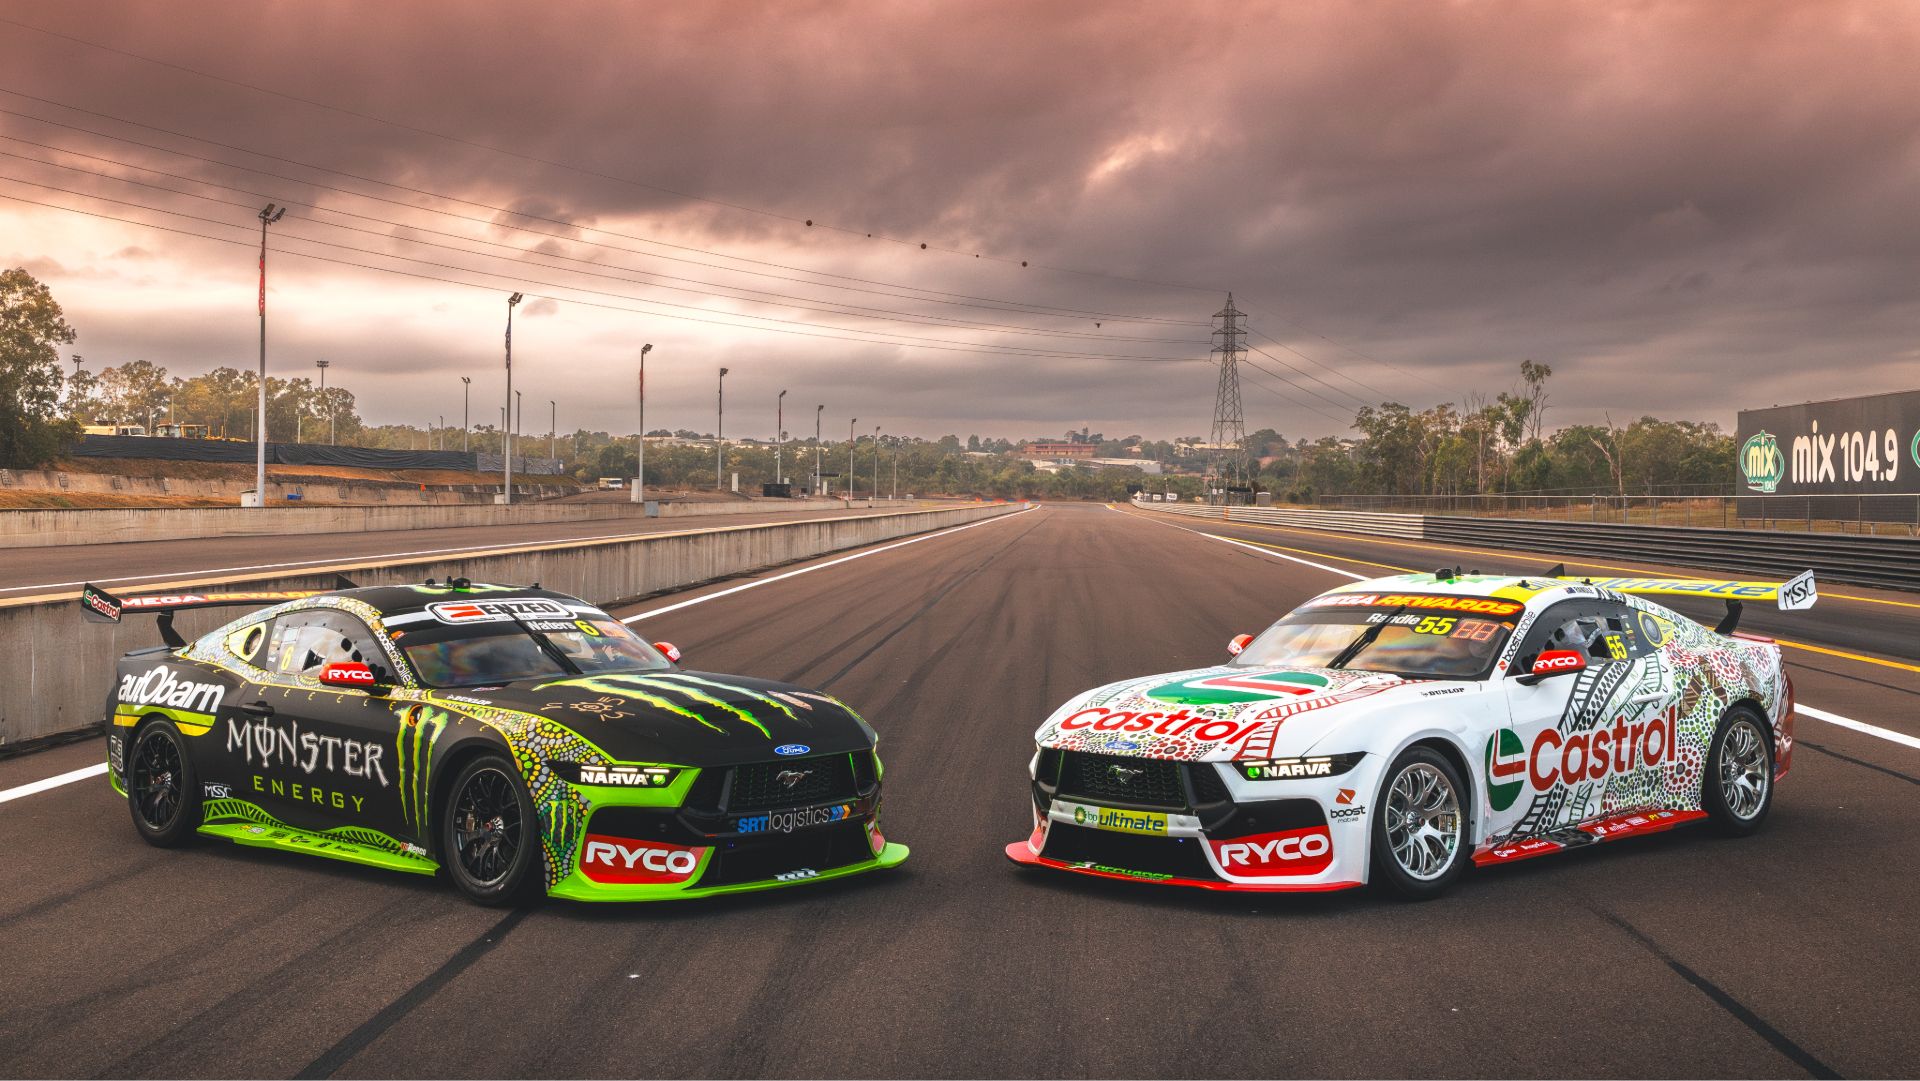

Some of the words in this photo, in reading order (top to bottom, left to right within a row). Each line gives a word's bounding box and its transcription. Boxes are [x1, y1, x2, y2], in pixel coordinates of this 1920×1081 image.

[1749, 433, 1775, 478] mix
[1792, 420, 1836, 484] mix
[1840, 428, 1899, 482] 104.9
[1592, 577, 1776, 597] ltimate
[91, 594, 120, 621] Castrol
[120, 594, 206, 607] MEGA
[478, 602, 561, 616] ENZED
[1374, 594, 1521, 614] REWARDS
[574, 620, 600, 636] 6
[1414, 616, 1457, 635] 55
[1605, 635, 1628, 660] 55
[1533, 656, 1578, 669] RYCO
[328, 669, 375, 680] RYCO
[1428, 687, 1465, 697] DUNLOP
[1060, 707, 1266, 745] Castrol
[227, 716, 389, 788] MONSTER
[1529, 703, 1676, 792] Castrol
[580, 771, 649, 786] NARVA
[1263, 763, 1332, 778] NARVA
[253, 775, 365, 812] ENERGY
[1100, 811, 1165, 832] ultimate
[1330, 805, 1366, 819] boost
[585, 841, 696, 874] RYCO
[1220, 833, 1330, 868] RYCO
